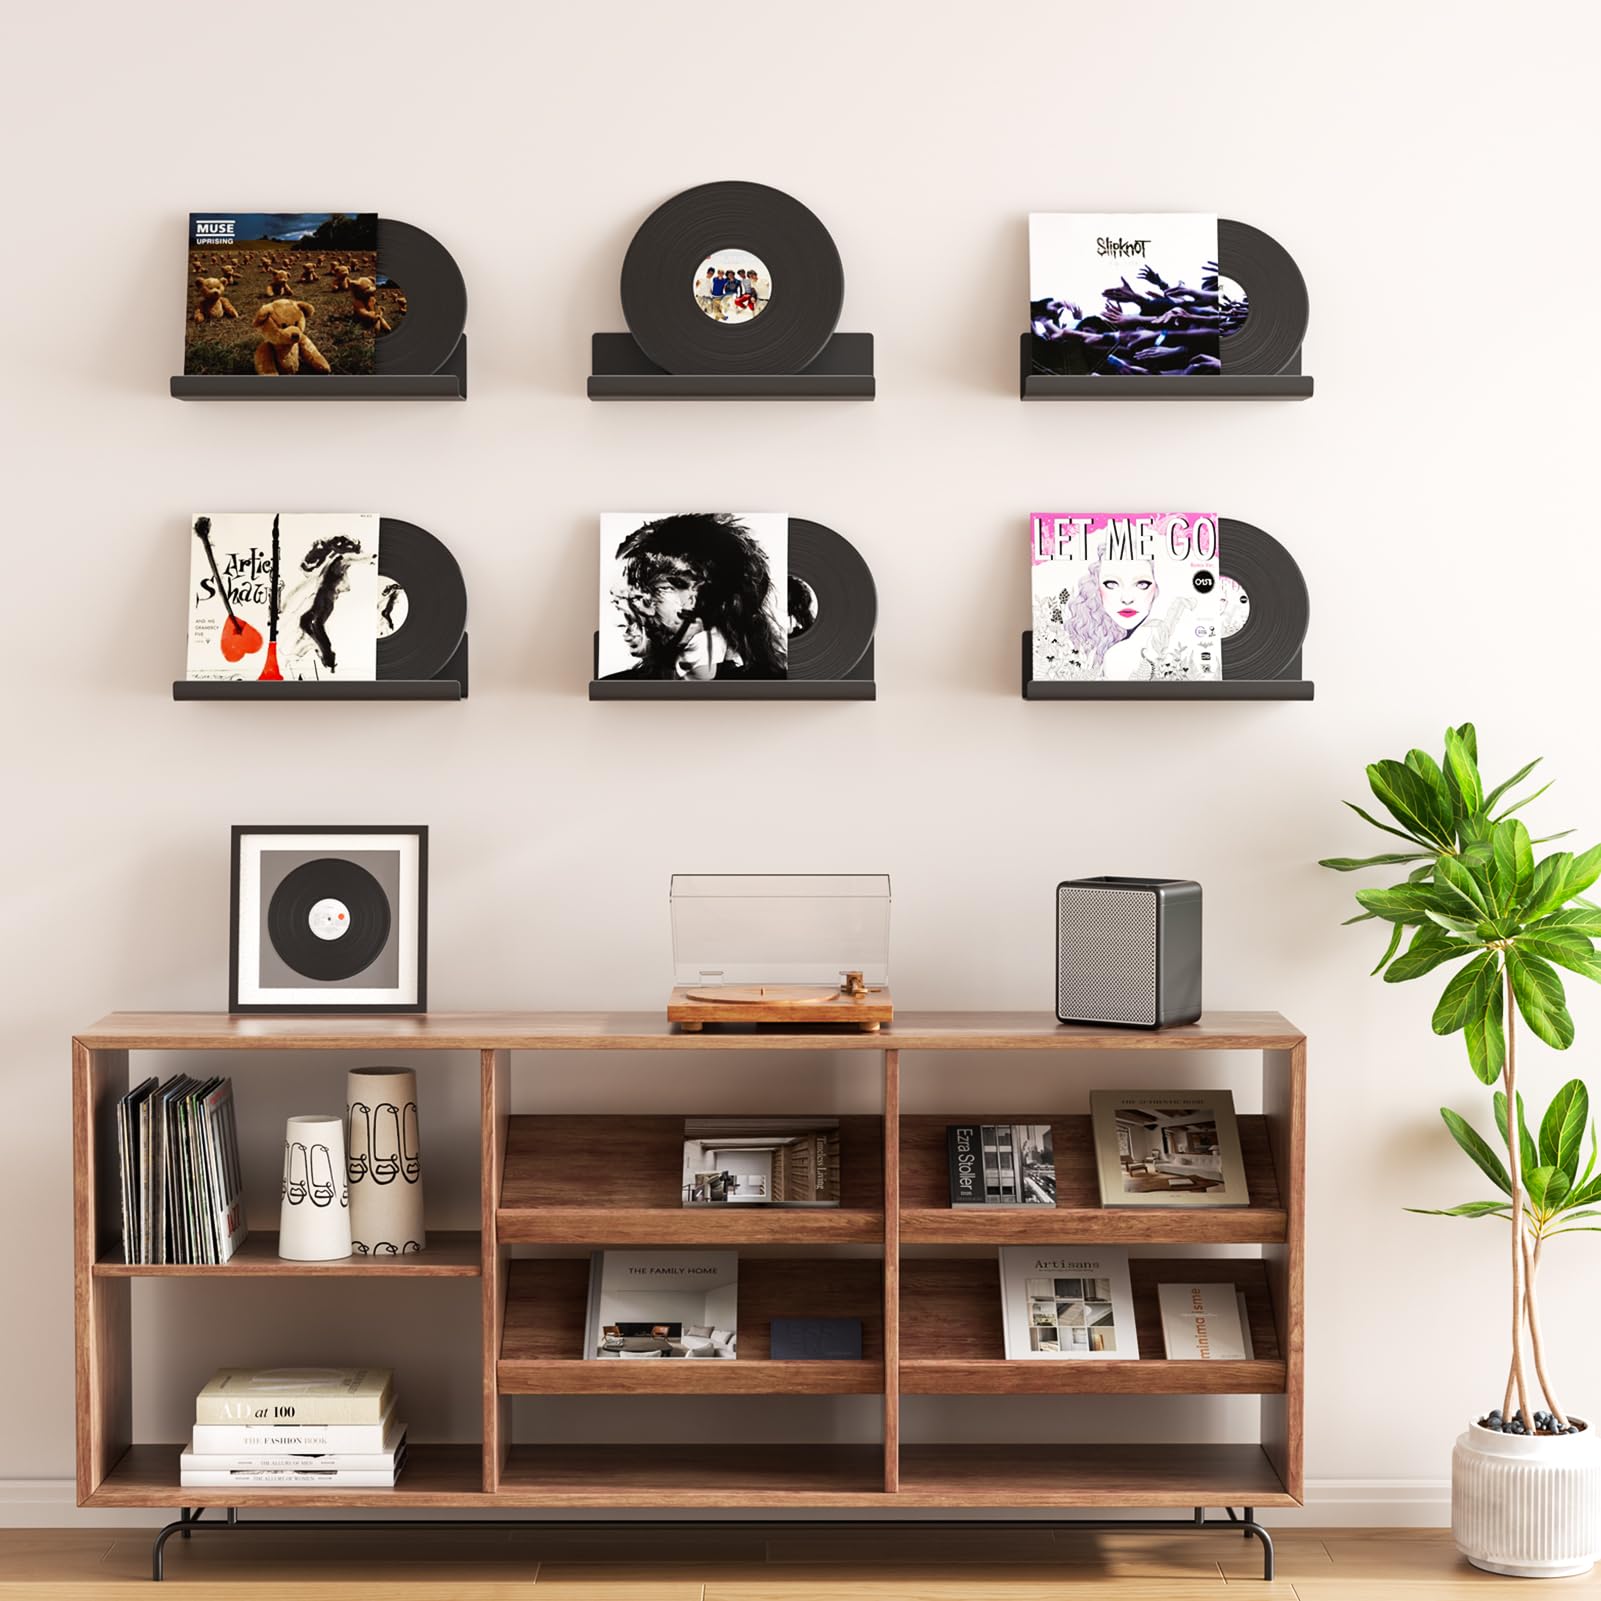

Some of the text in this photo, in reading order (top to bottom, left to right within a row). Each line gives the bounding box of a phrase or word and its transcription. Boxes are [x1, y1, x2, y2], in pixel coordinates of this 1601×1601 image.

[196, 223, 235, 234] MUSE
[1033, 517, 1216, 561] LET ME GO
[223, 547, 273, 581] Artie
[196, 575, 271, 609] Shaw
[956, 1128, 974, 1152] Ezra
[958, 1154, 976, 1191] Stoller
[1034, 1259, 1100, 1269] Artisans
[254, 1407, 268, 1419] at
[273, 1406, 296, 1418] 100
